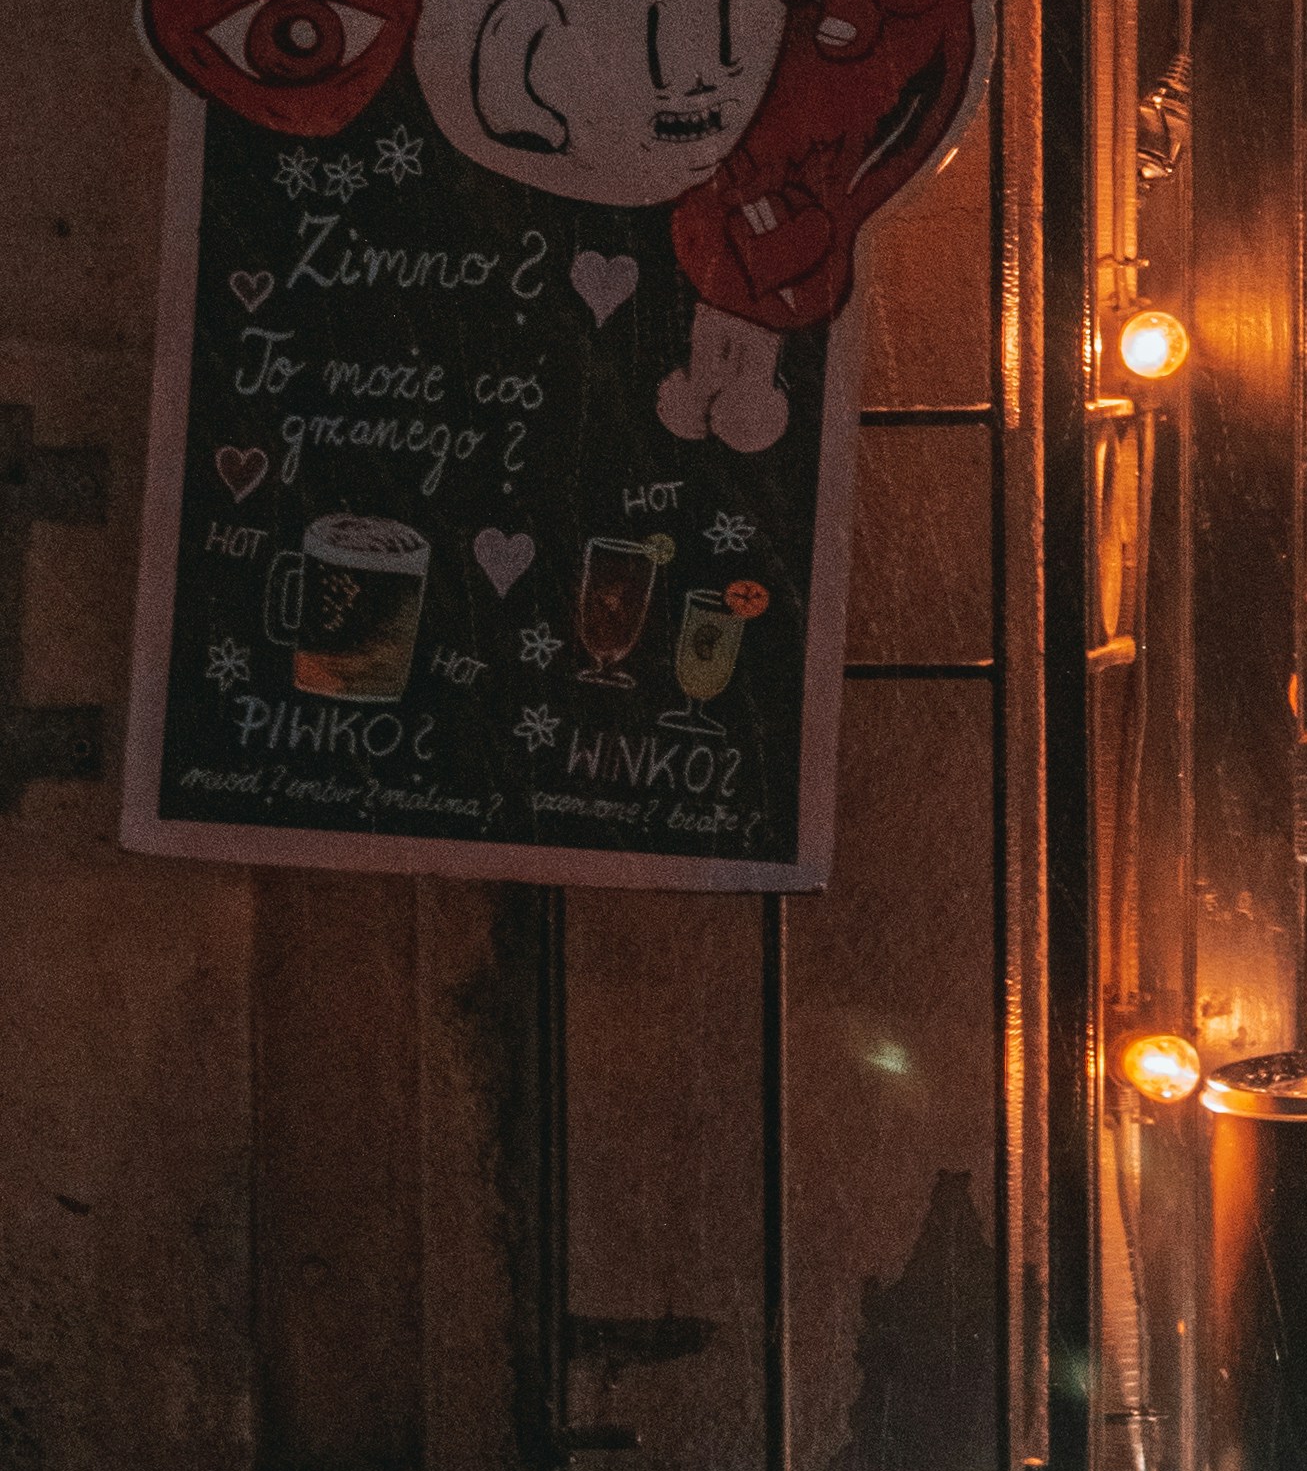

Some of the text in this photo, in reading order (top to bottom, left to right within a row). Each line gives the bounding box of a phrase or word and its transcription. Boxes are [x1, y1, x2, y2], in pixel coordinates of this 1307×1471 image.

[235, 325, 545, 410] To może coś
[623, 480, 685, 516] HOT
[205, 521, 268, 562] HOT
[430, 644, 489, 687] HOT
